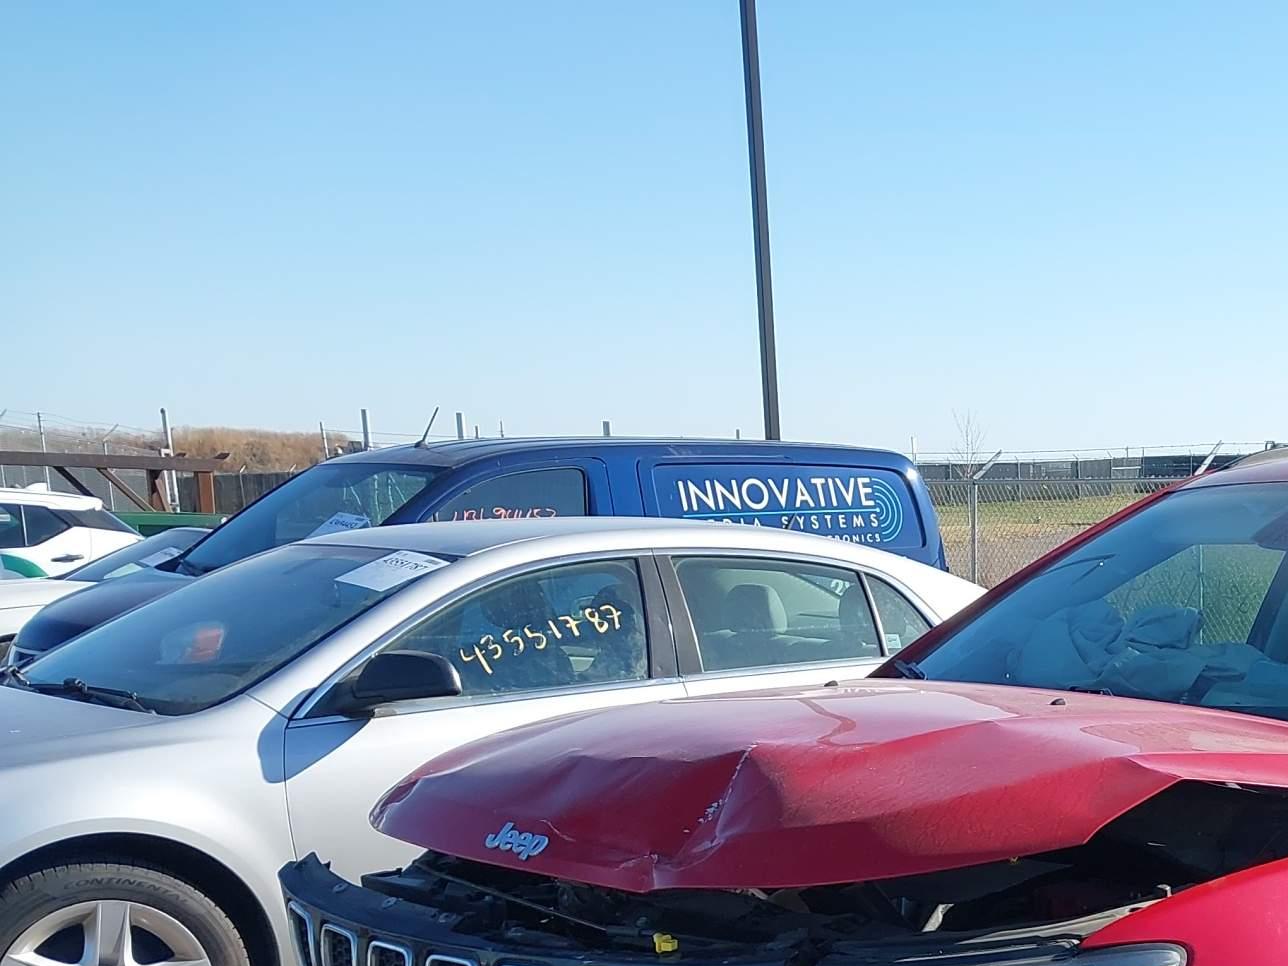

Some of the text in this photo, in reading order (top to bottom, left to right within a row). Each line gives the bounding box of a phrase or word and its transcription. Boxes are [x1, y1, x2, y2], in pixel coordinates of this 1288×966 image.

[677, 477, 875, 511] INNOVATIVE
[782, 513, 879, 529] SYSTEMS
[460, 604, 622, 674] 43551787
[485, 822, 549, 860] Jeep
